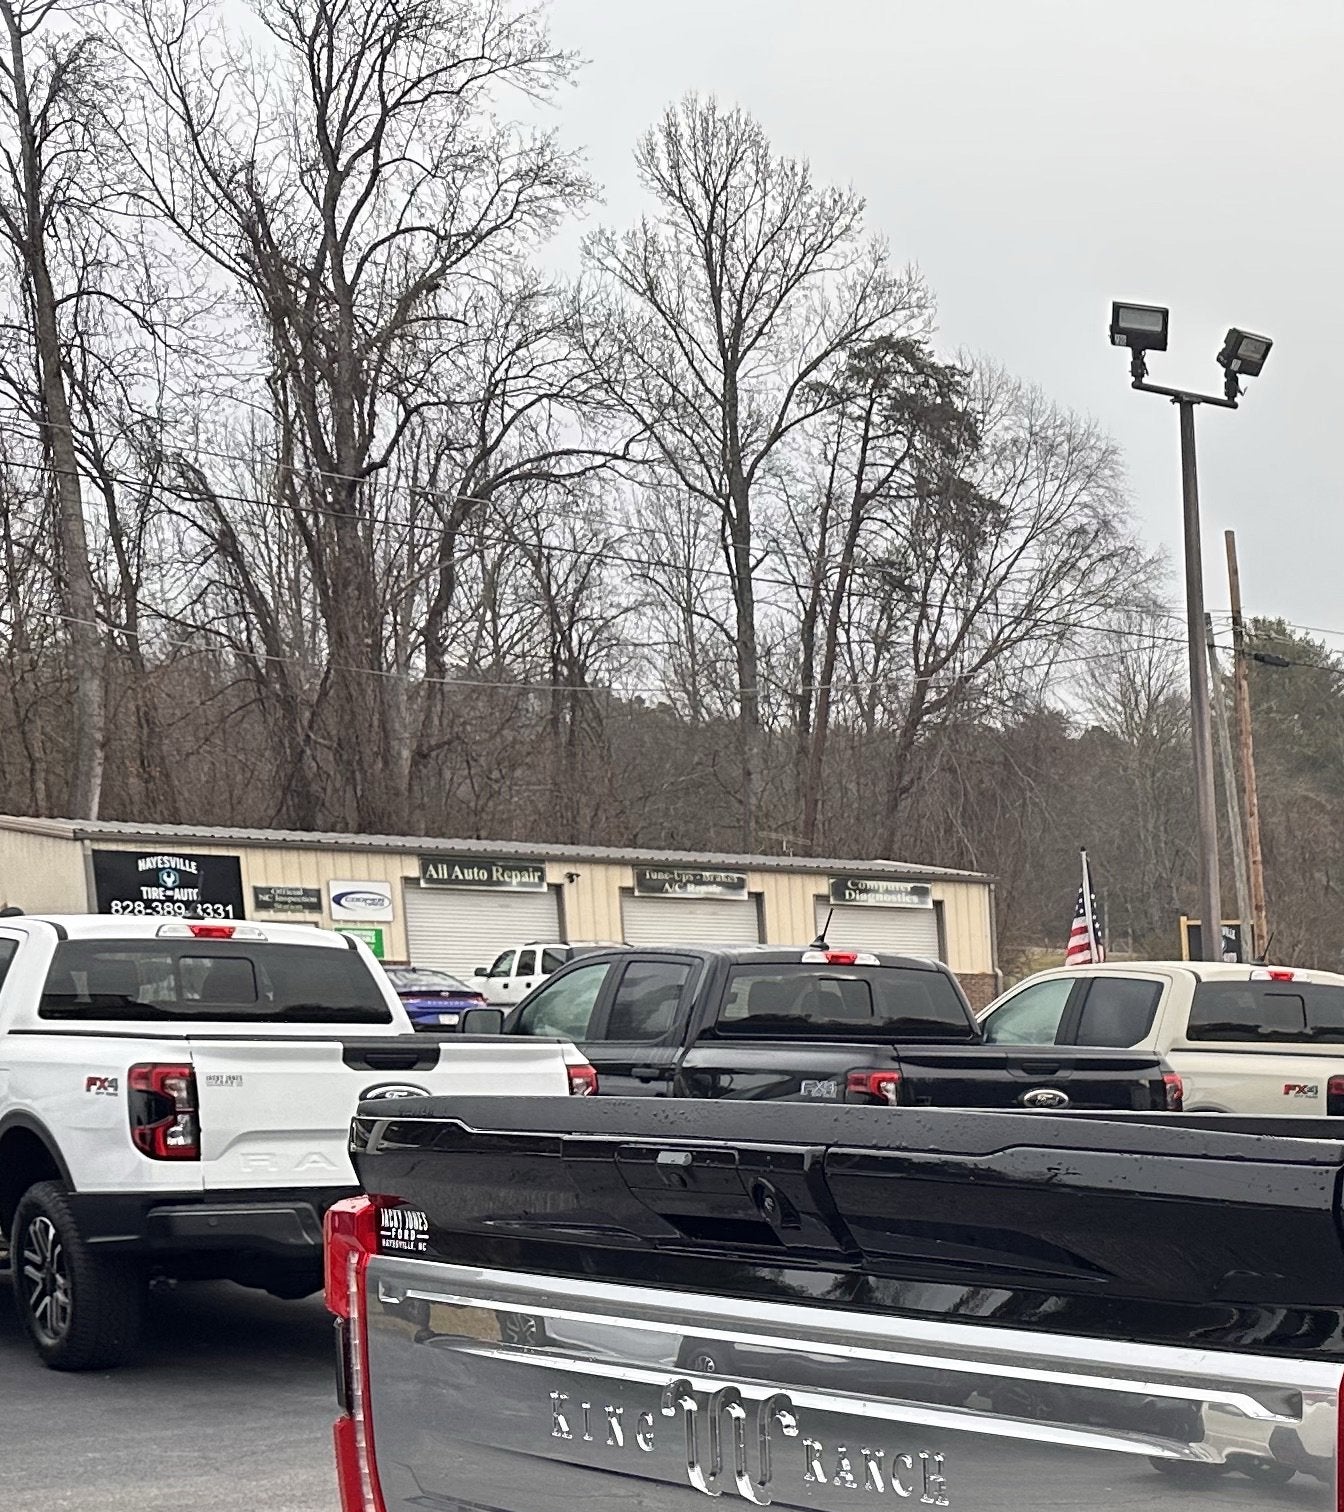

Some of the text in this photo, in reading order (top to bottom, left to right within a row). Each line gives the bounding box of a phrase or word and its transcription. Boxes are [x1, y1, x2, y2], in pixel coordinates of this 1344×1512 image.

[137, 856, 198, 874] HAYESVILLE
[425, 863, 541, 886] All Auto Repair
[662, 882, 684, 893] A/C
[847, 880, 912, 892] Computer
[845, 889, 919, 904] Diagnostics
[86, 1076, 118, 1092] FX4
[1283, 1084, 1319, 1096] FX4
[380, 1207, 429, 1231] JACKY JONES
[391, 1227, 416, 1240] FORD
[548, 1389, 951, 1507] KING RANCH
